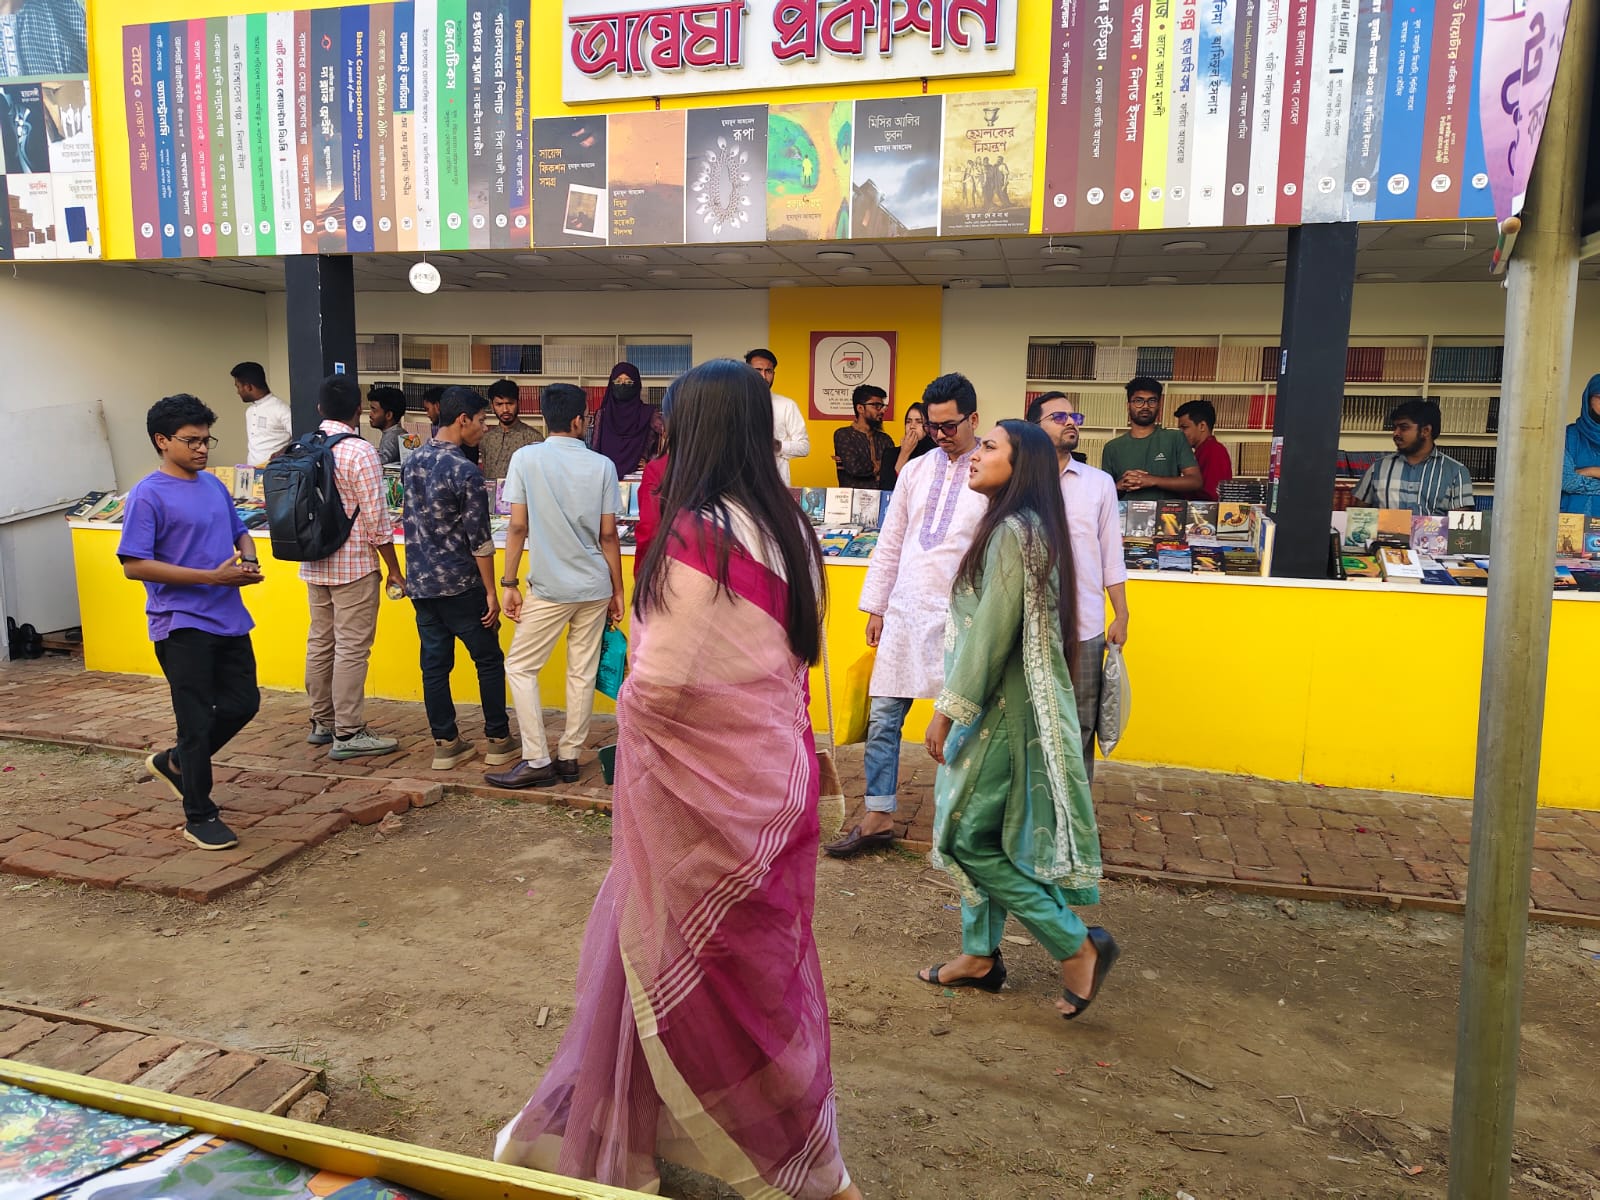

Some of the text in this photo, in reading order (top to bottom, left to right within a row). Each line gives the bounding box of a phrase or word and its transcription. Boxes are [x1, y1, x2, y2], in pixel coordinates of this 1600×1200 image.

[1180, 9, 1195, 31] গল্প
[1245, 20, 1253, 37] School
[494, 13, 504, 77] পাতালঘরের
[569, 0, 999, 76] অন্বেষা প্রকাশন
[1093, 15, 1114, 60] ইতিহাস
[1155, 34, 1167, 58] জানে
[1181, 37, 1193, 54] ছড়া
[1447, 13, 1466, 59] থিয়েটার
[213, 33, 221, 64] একজন
[233, 43, 240, 59] এক
[445, 20, 459, 89] জেনেটিকস
[1243, 51, 1251, 68] Golden
[1294, 30, 1306, 66] জানালায়
[194, 63, 203, 81] আছি
[472, 55, 482, 84] সন্ধানে
[1125, 4, 1144, 142] অপেক্ষা নিশাত ইসলাম
[1155, 62, 1165, 88] আলম
[1182, 56, 1194, 73] ছবি
[1207, 36, 1224, 115] আমিনুল ইসলাম
[1241, 69, 1250, 79] Age
[233, 62, 242, 102] নিঃশ্বাসের
[1095, 78, 1103, 103] মোস্তফা
[1291, 79, 1302, 95] শাহ
[1366, 76, 1374, 96] ২০২৪
[131, 45, 143, 87] বাবর
[138, 143, 149, 171] শরীফ
[214, 89, 223, 120] মানুষের
[355, 59, 364, 140] Correspondence
[473, 93, 483, 124] নাজনীন
[494, 80, 506, 115] পিশাচ
[195, 103, 203, 123] ভালো
[234, 106, 242, 120] গল্প
[868, 112, 921, 129] মিসির আলির
[1261, 109, 1270, 132] হাসান
[1290, 97, 1300, 125] সোহেল
[216, 123, 224, 137] গল্প
[473, 126, 484, 156] পারভীন
[732, 127, 755, 142] রূপা
[883, 130, 904, 143] ভুবন
[965, 127, 1016, 140] হেমলকের
[973, 141, 1008, 154] নিমন্ত্রণ
[1362, 134, 1371, 157] ইসলাম
[538, 162, 566, 175] ফিকশন
[496, 177, 504, 193] খান
